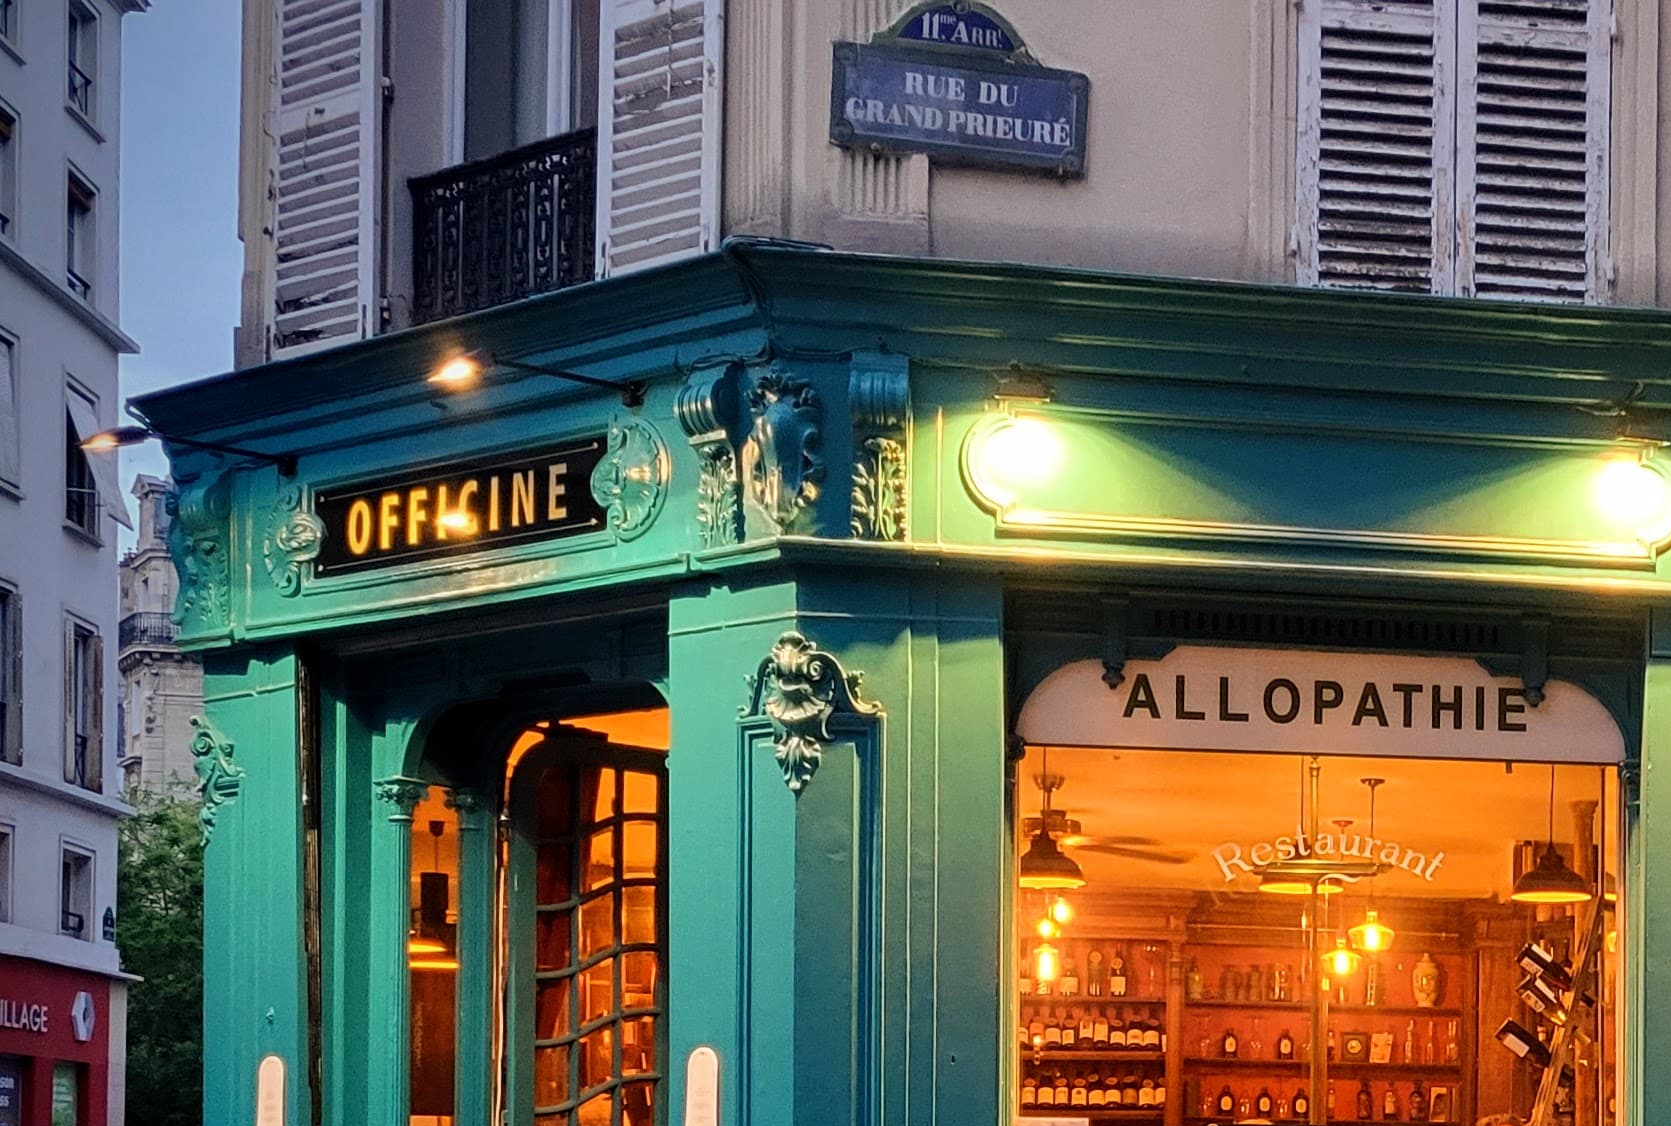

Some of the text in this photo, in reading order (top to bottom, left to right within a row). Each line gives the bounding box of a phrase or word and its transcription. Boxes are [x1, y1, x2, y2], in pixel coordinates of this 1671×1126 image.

[905, 71, 1019, 107] RUE DU
[845, 97, 1071, 147] GRAND PRIEURÉ
[347, 462, 568, 556] OFFICINE
[1122, 673, 1528, 733] ALLOPATHIE
[1210, 824, 1446, 883] Restaurant
